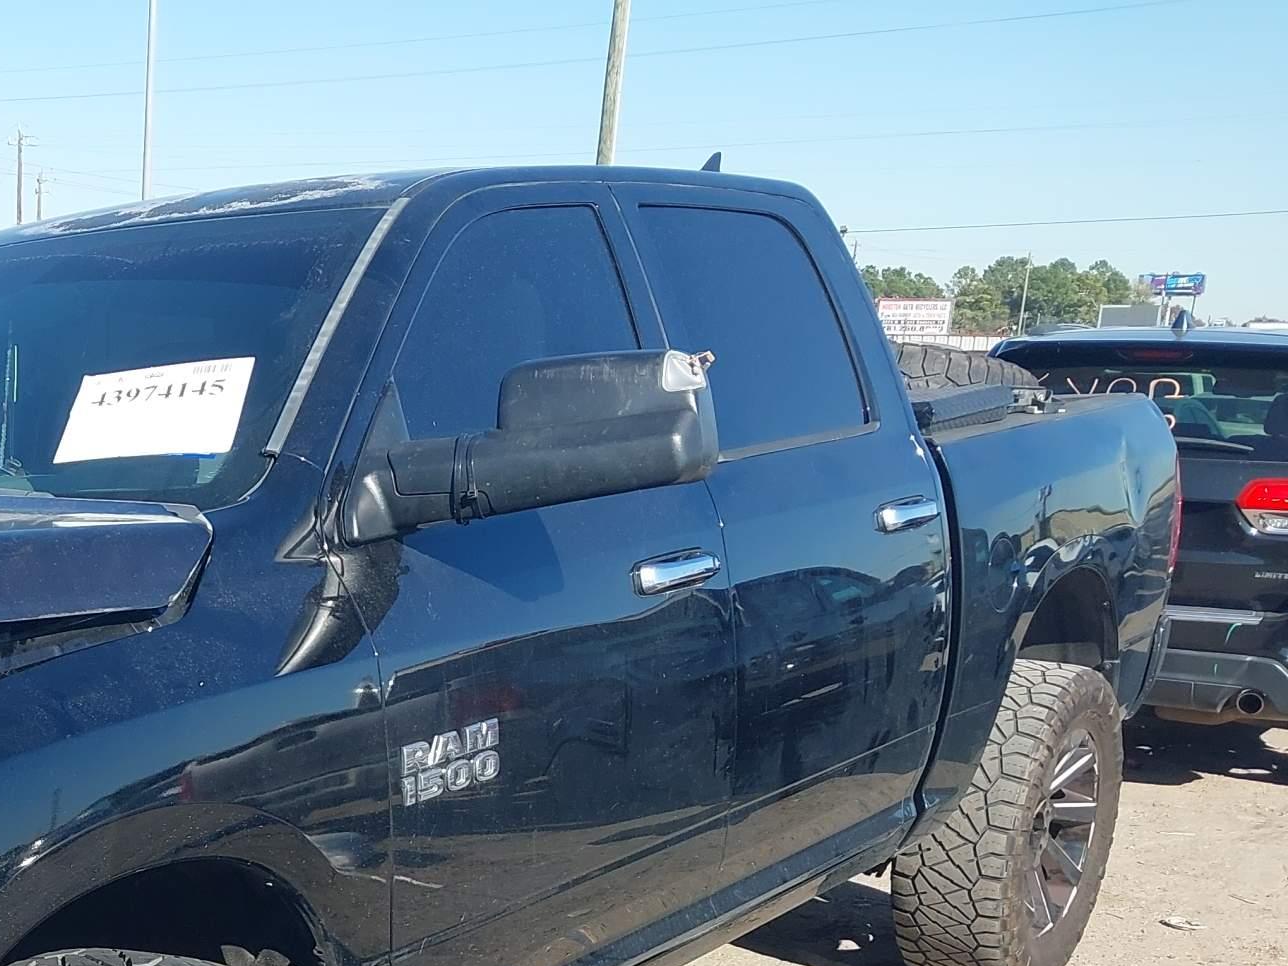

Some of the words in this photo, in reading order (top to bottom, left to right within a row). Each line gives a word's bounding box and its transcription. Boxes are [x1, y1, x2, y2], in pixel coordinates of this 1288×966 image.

[92, 379, 225, 406] 43974145
[401, 717, 499, 776] RAM
[401, 750, 500, 806] 1500
